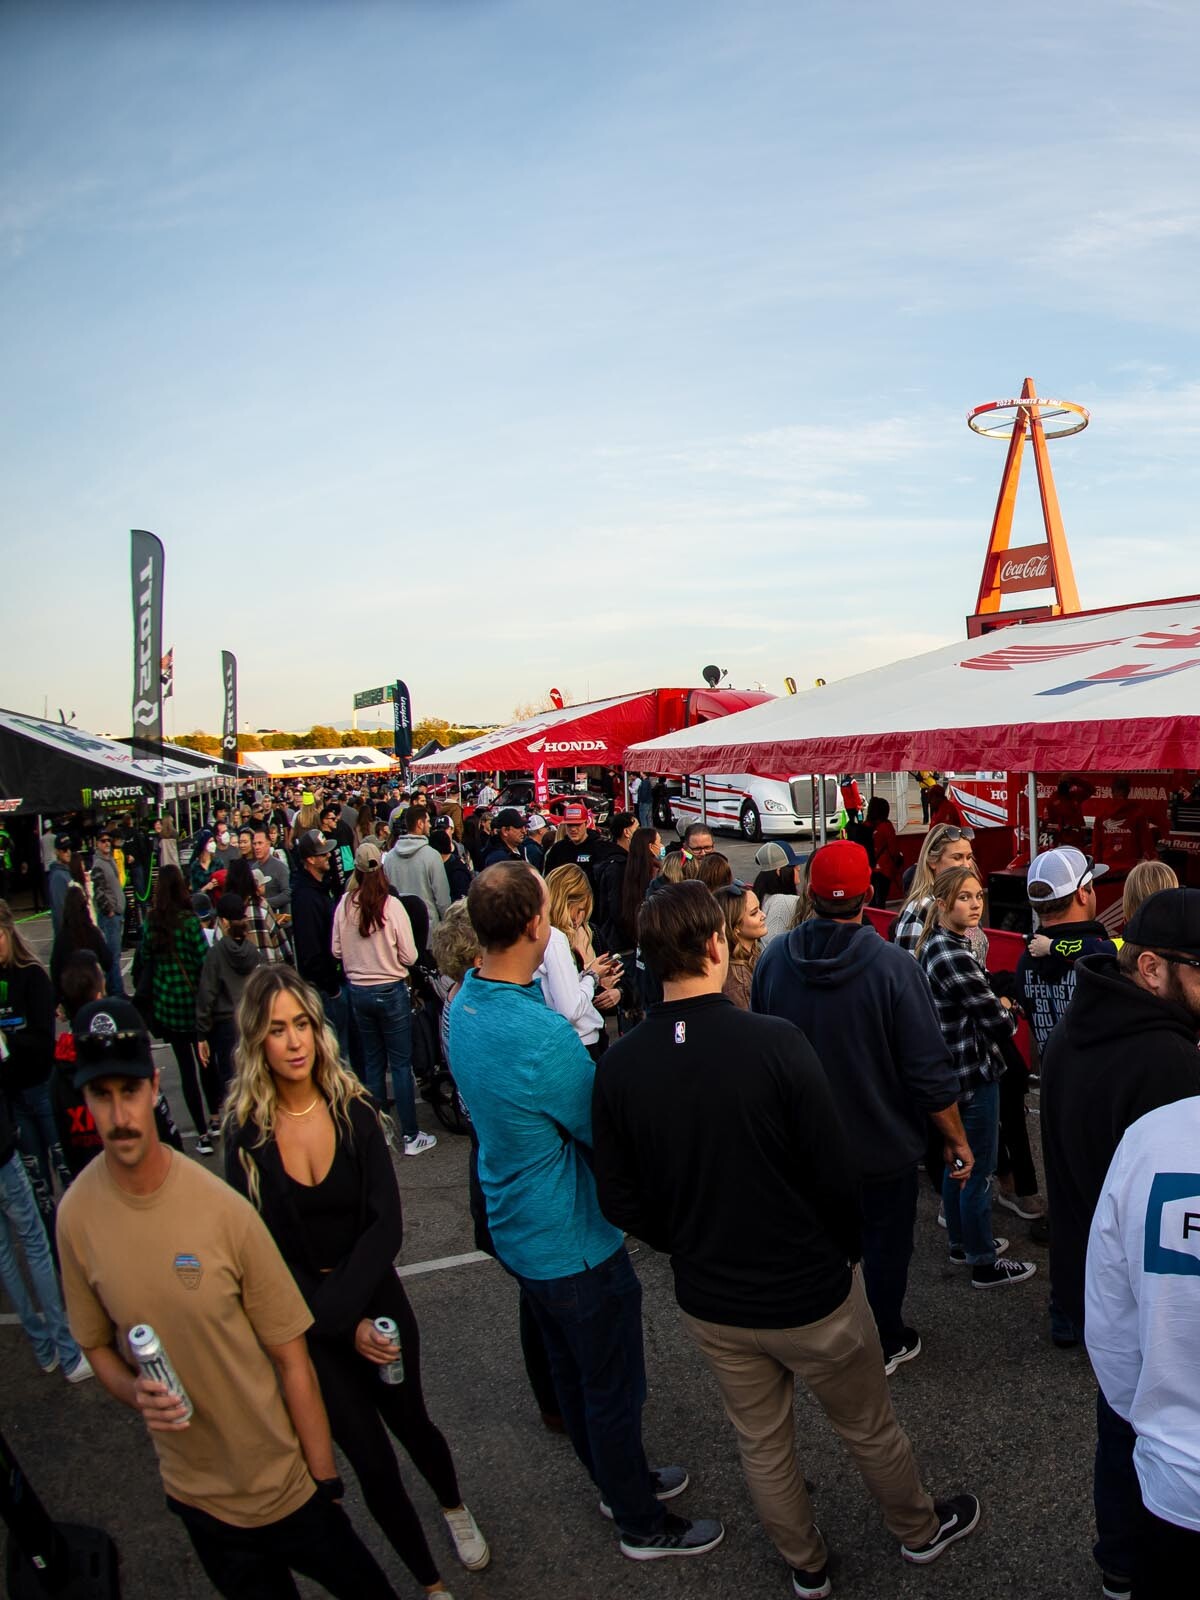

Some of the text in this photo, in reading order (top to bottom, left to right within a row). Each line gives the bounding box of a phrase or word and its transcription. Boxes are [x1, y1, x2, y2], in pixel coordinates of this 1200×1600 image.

[1000, 554, 1050, 582] Coca-Cola
[544, 740, 608, 752] HONDA
[282, 753, 376, 769] KTM
[93, 786, 144, 800] MONSTER
[100, 798, 137, 807] ENERGY
[1035, 998, 1050, 1013] SO
